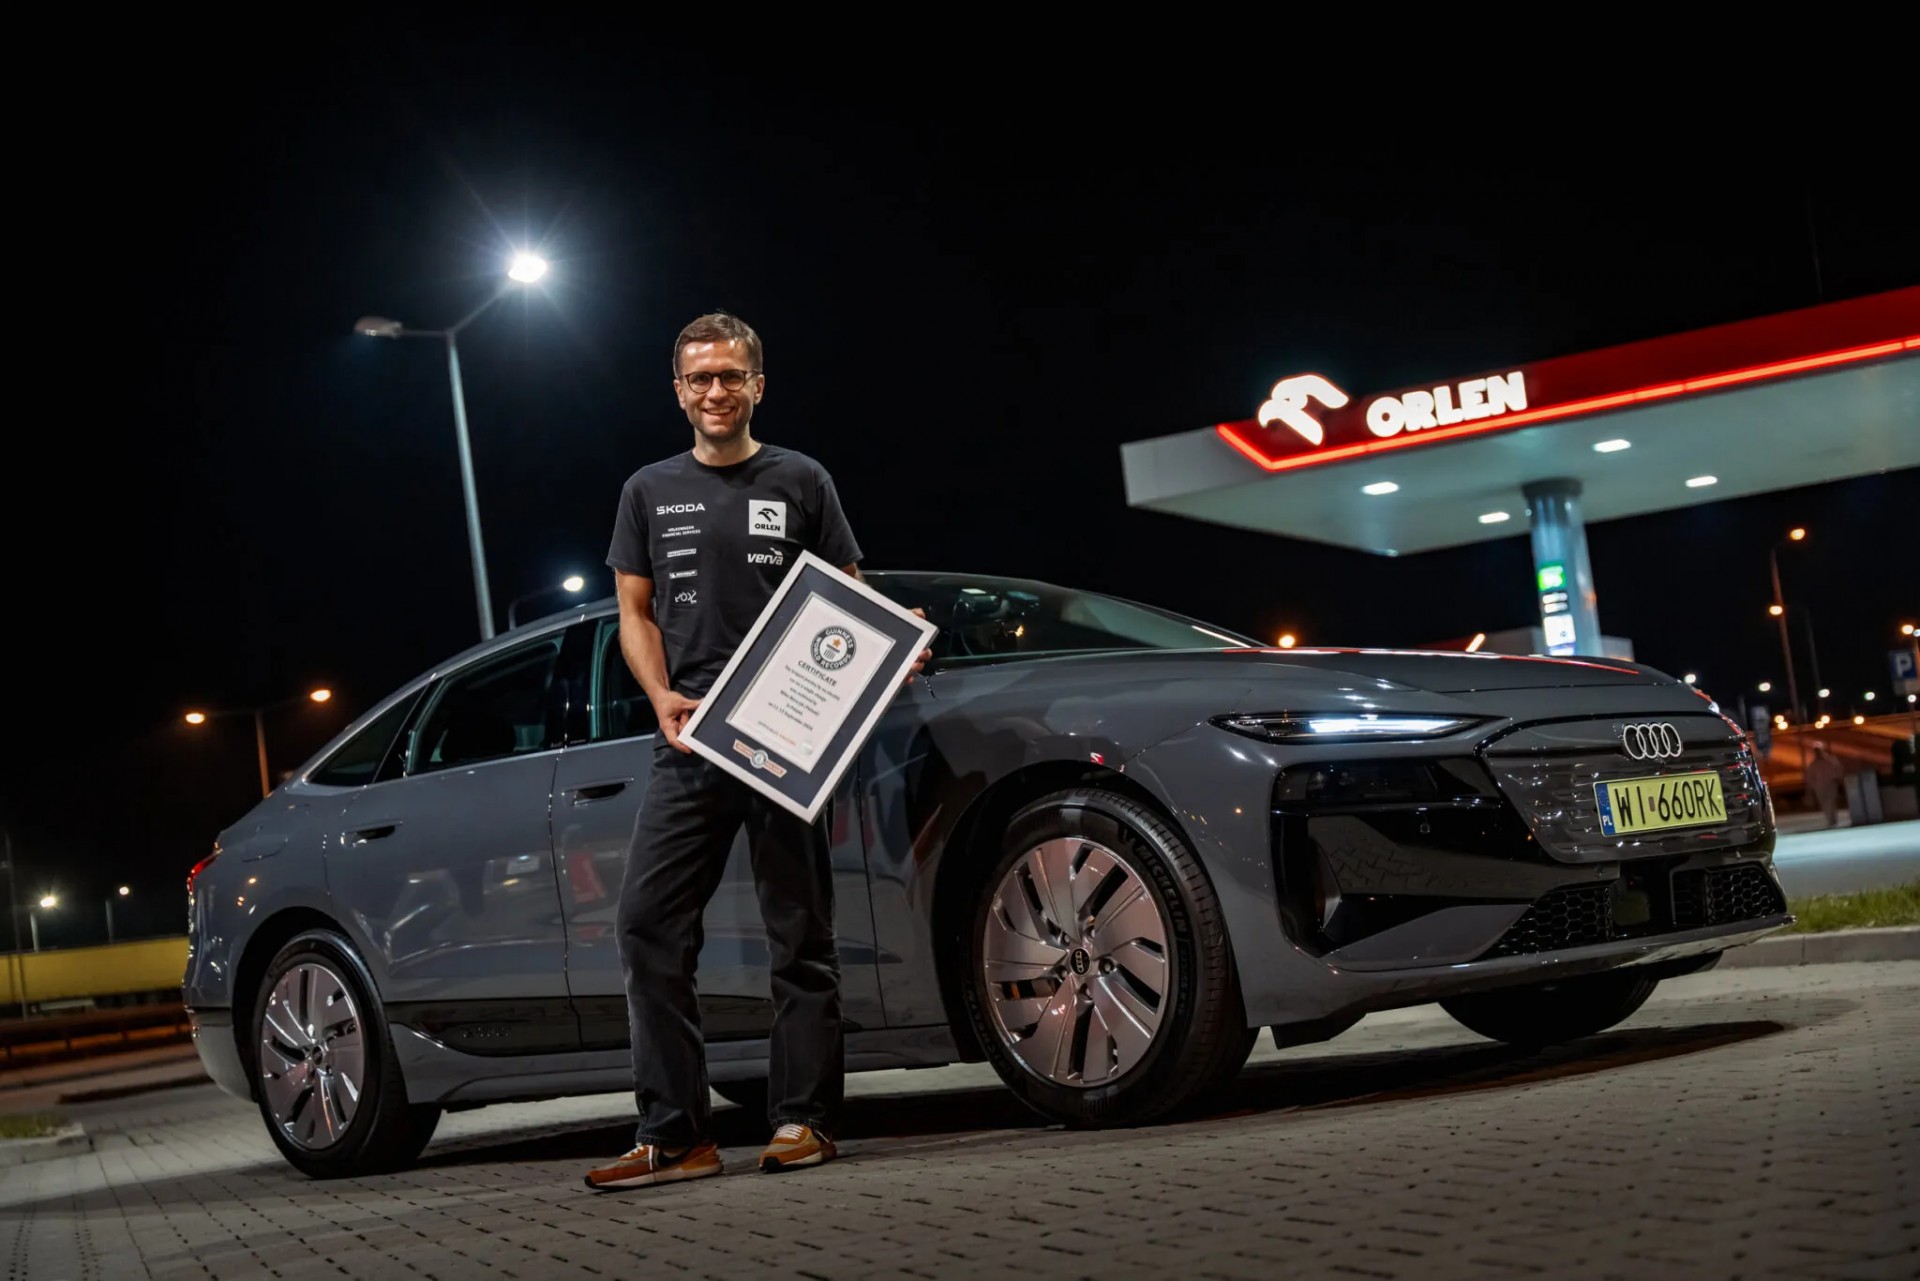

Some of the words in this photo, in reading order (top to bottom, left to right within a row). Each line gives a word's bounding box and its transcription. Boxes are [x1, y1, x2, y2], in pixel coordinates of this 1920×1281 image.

[1366, 371, 1528, 438] ORLEN
[754, 523, 781, 532] ORLEN
[747, 553, 784, 566] verva
[825, 627, 854, 649] GUINNESS
[813, 636, 823, 661] WORLD
[820, 653, 852, 668] RECORDS
[1895, 652, 1913, 677] P
[797, 660, 838, 687] CERTIFICATE
[1614, 786, 1646, 827] WI
[1658, 778, 1721, 822] 660RK
[1602, 815, 1613, 826] PL
[1138, 845, 1188, 935] MICHELIN
